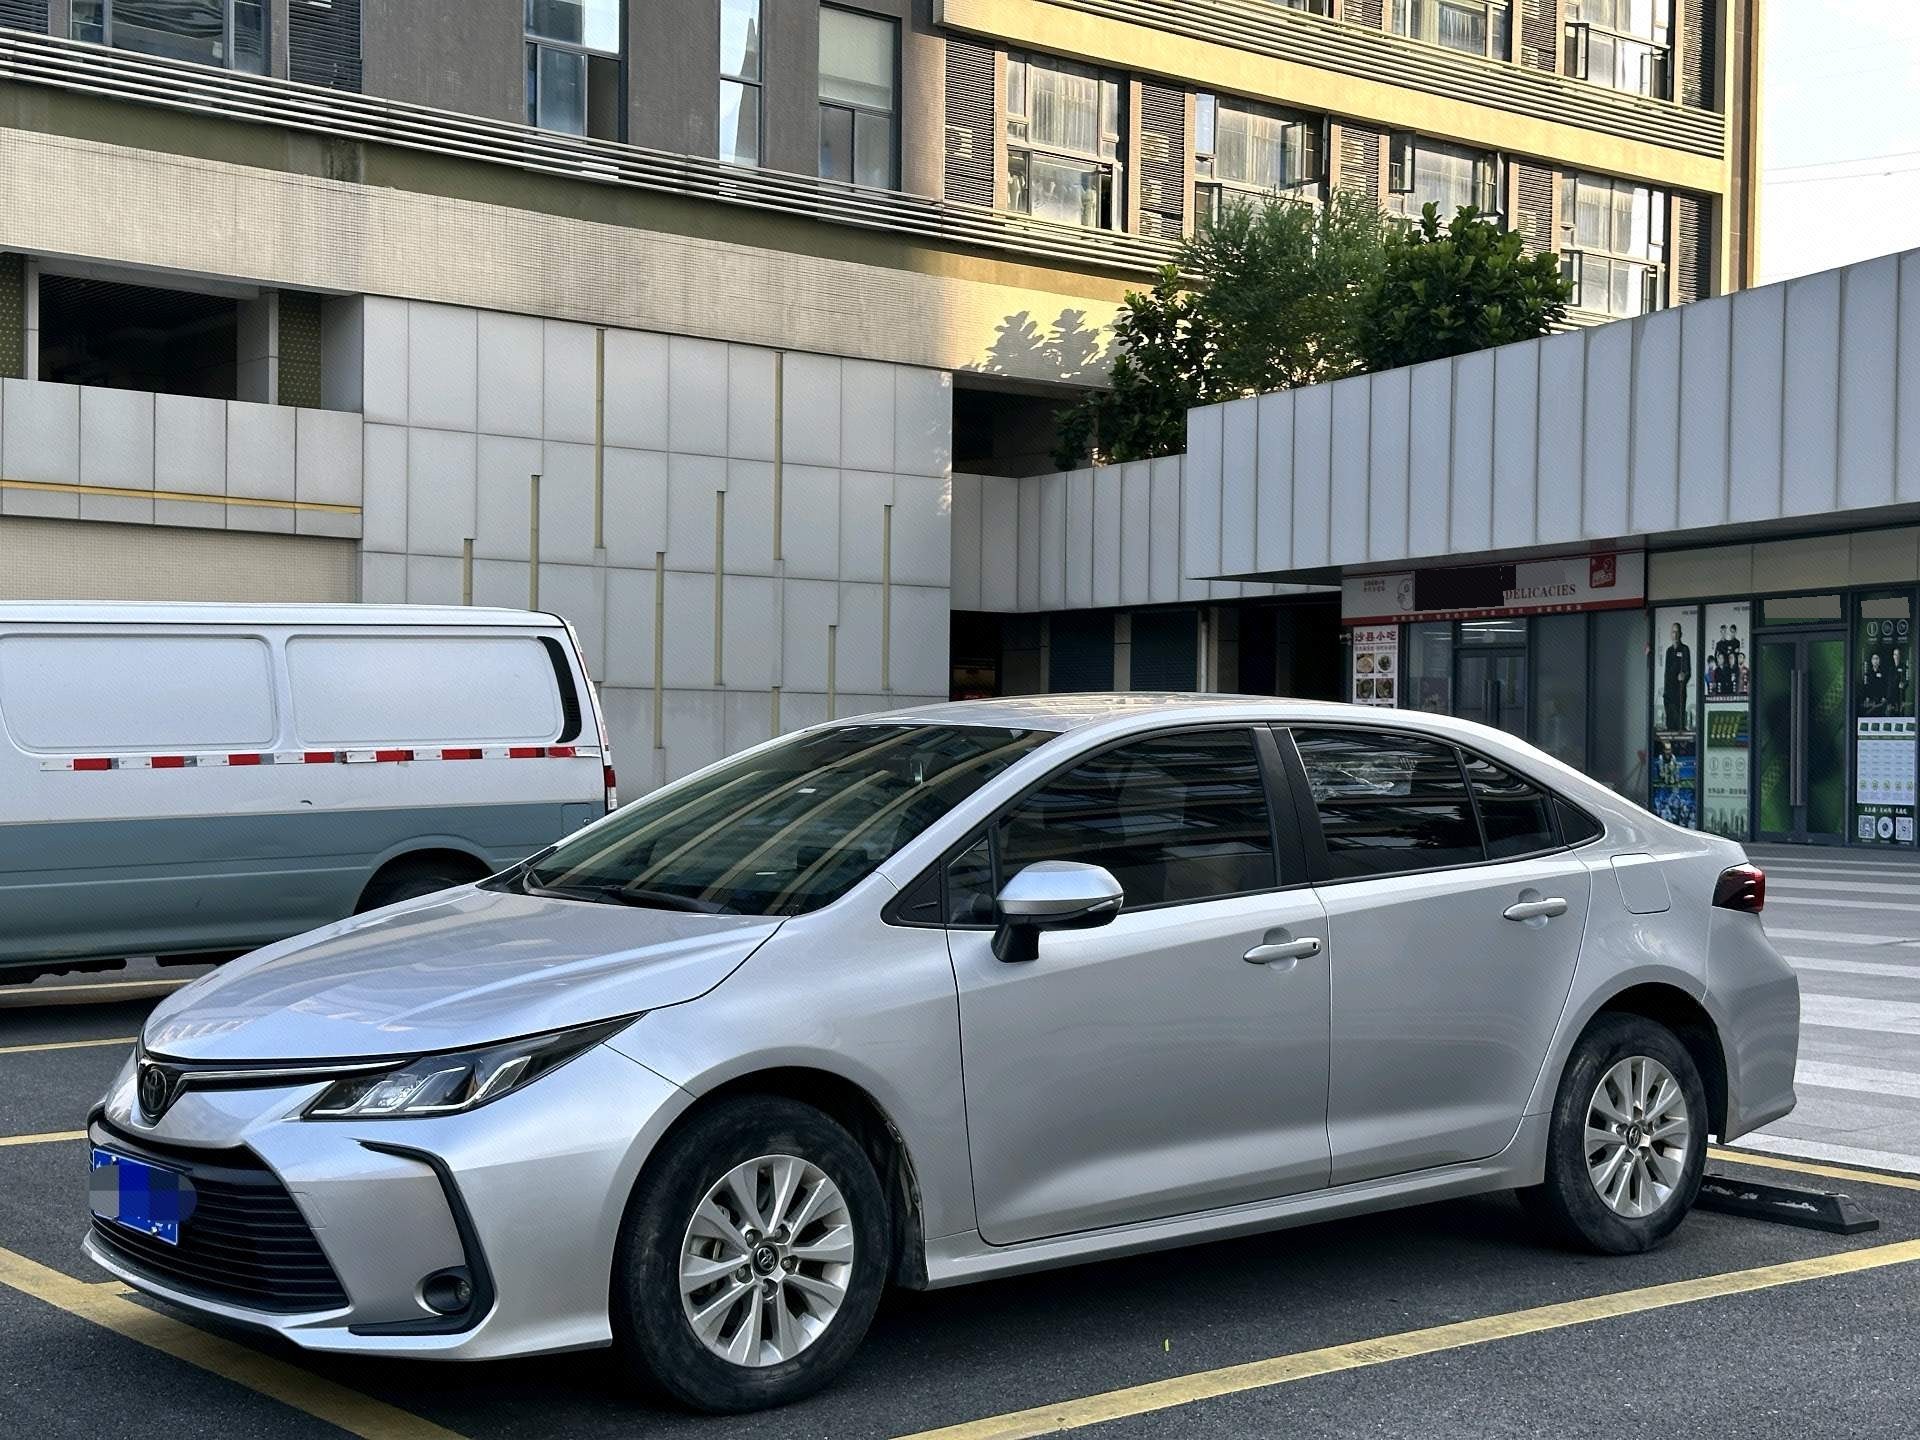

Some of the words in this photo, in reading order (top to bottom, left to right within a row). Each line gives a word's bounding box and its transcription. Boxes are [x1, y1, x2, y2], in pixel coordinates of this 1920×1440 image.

[1505, 584, 1576, 600] DELICACIES
[1354, 631, 1397, 642] 沙县小吃
